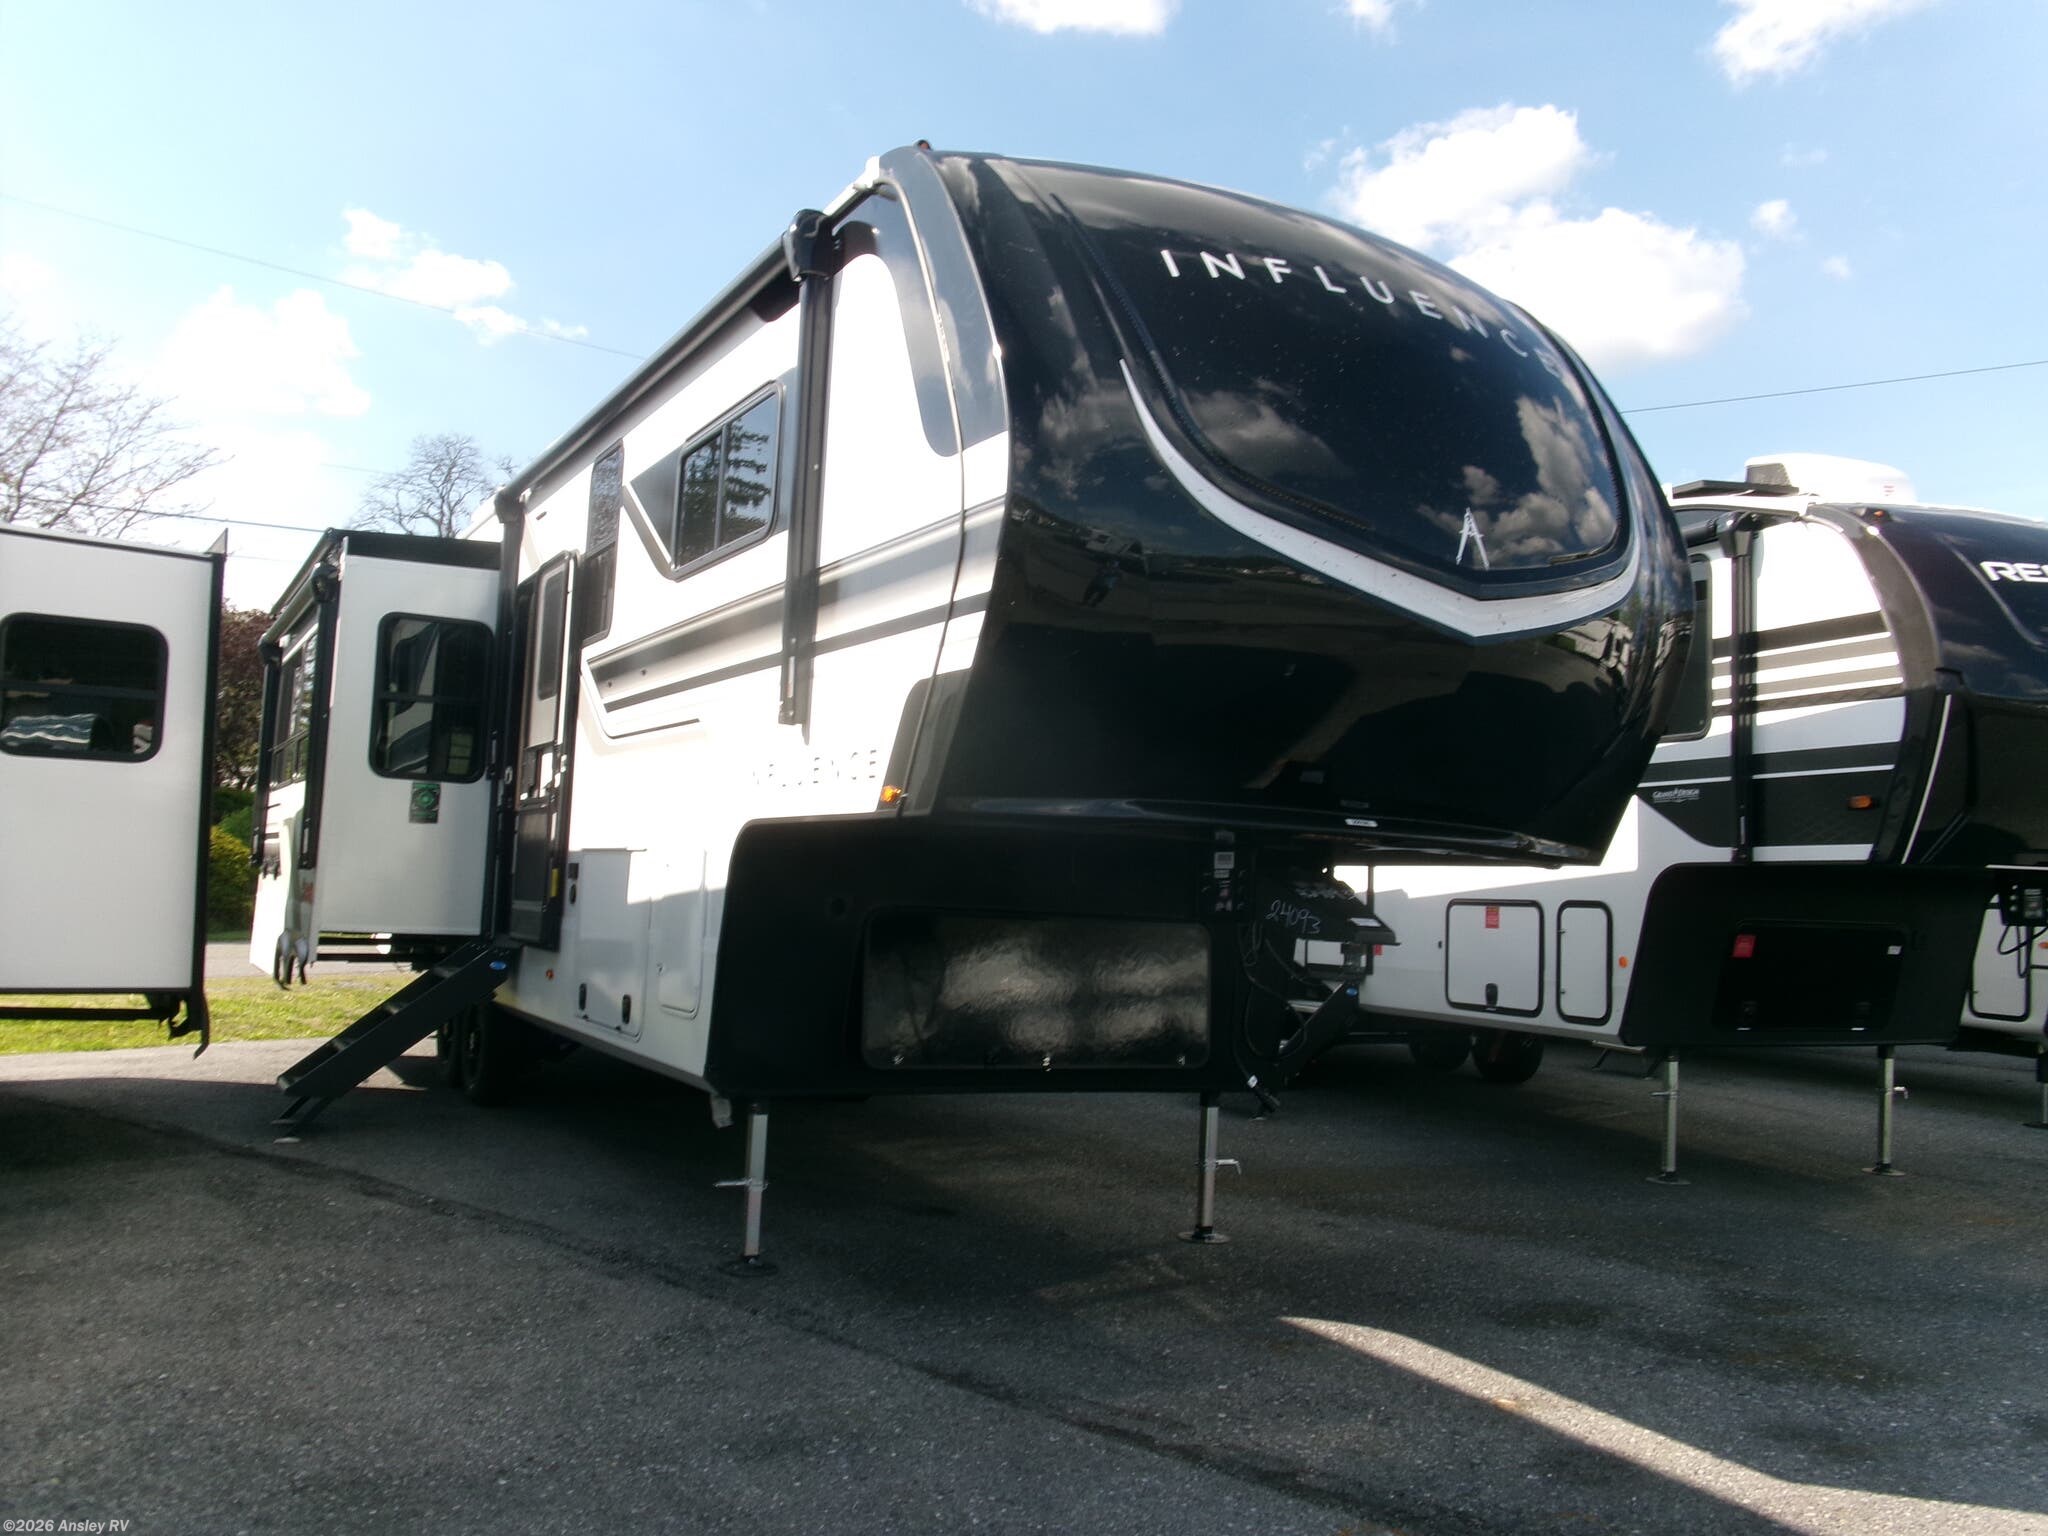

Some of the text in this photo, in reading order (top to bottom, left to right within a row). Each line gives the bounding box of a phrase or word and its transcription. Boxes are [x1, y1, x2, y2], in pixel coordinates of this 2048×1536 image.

[1161, 249, 1562, 379] INFLUENCE
[1980, 561, 2048, 583] RE
[1265, 899, 1321, 934] 24093
